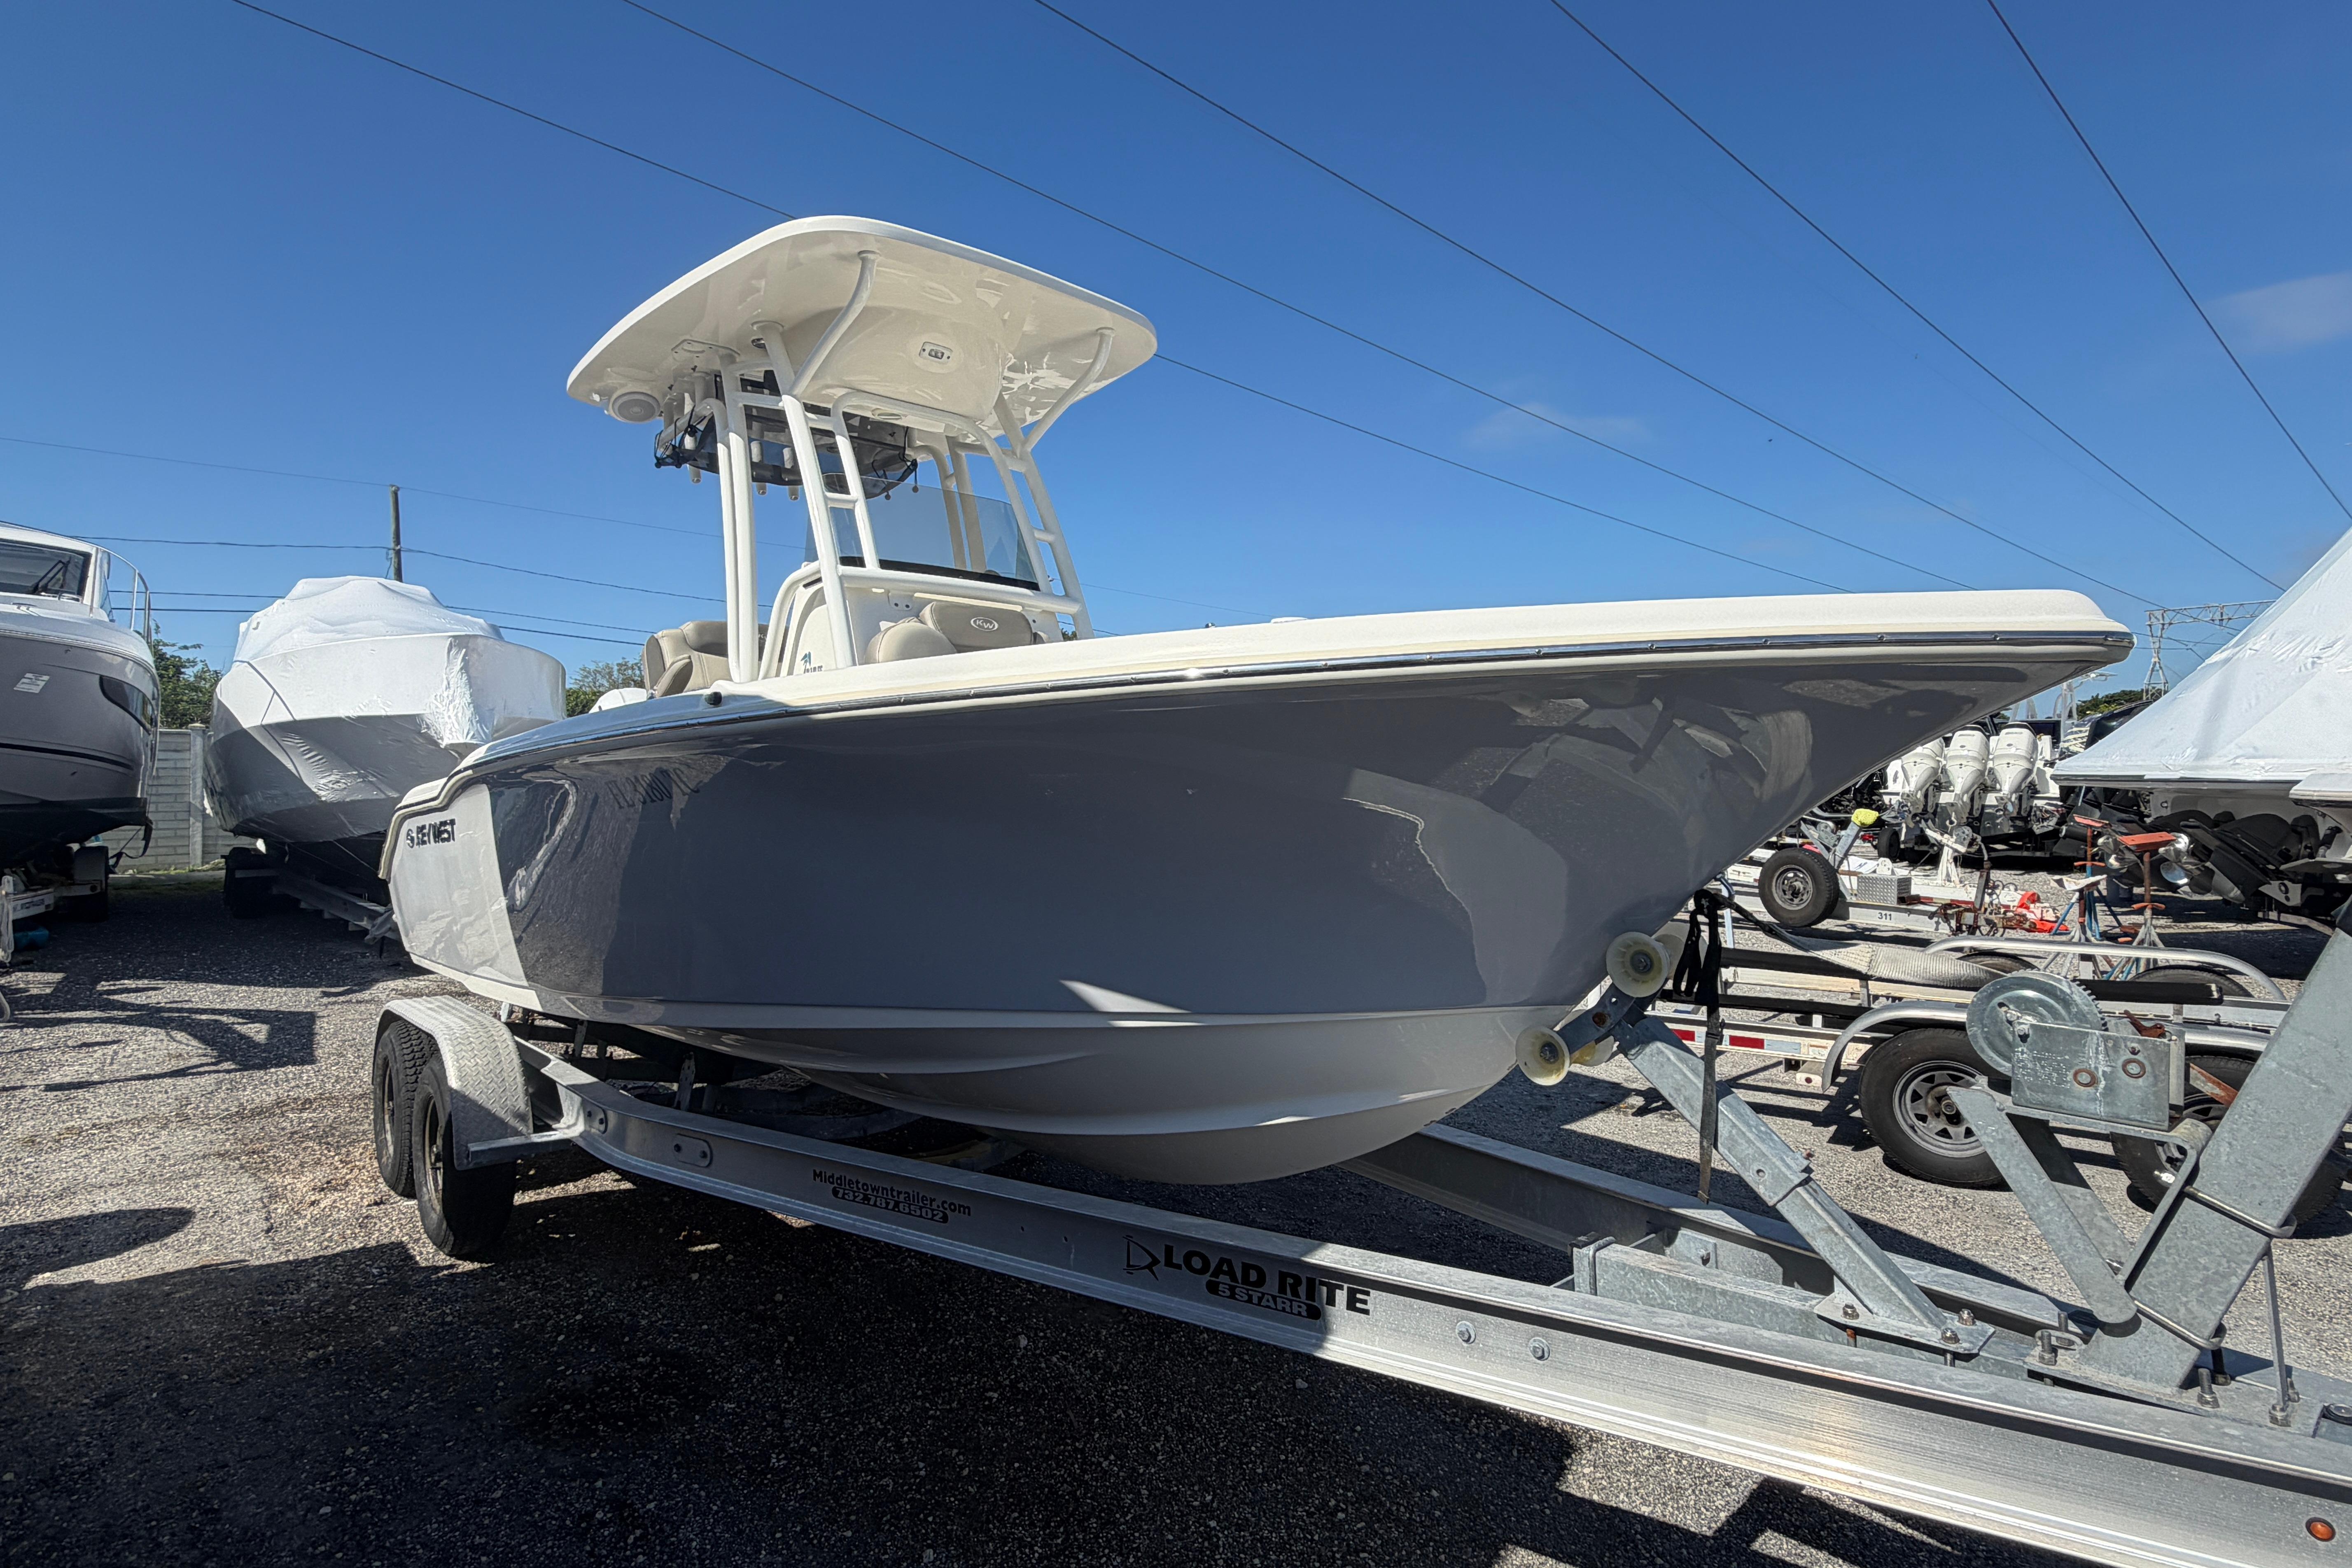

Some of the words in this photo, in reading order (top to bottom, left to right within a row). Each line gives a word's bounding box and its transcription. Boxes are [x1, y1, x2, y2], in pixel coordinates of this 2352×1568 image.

[976, 619, 994, 629] KW
[1878, 912, 1892, 921] 311
[813, 1169, 971, 1216] Middletowntrailer.com
[835, 1187, 943, 1221] 732.787.6502
[1164, 1244, 1267, 1288] LOAD
[1278, 1270, 1370, 1316] RITE
[1218, 1283, 1230, 1297] 5
[1235, 1289, 1308, 1317] STARR
